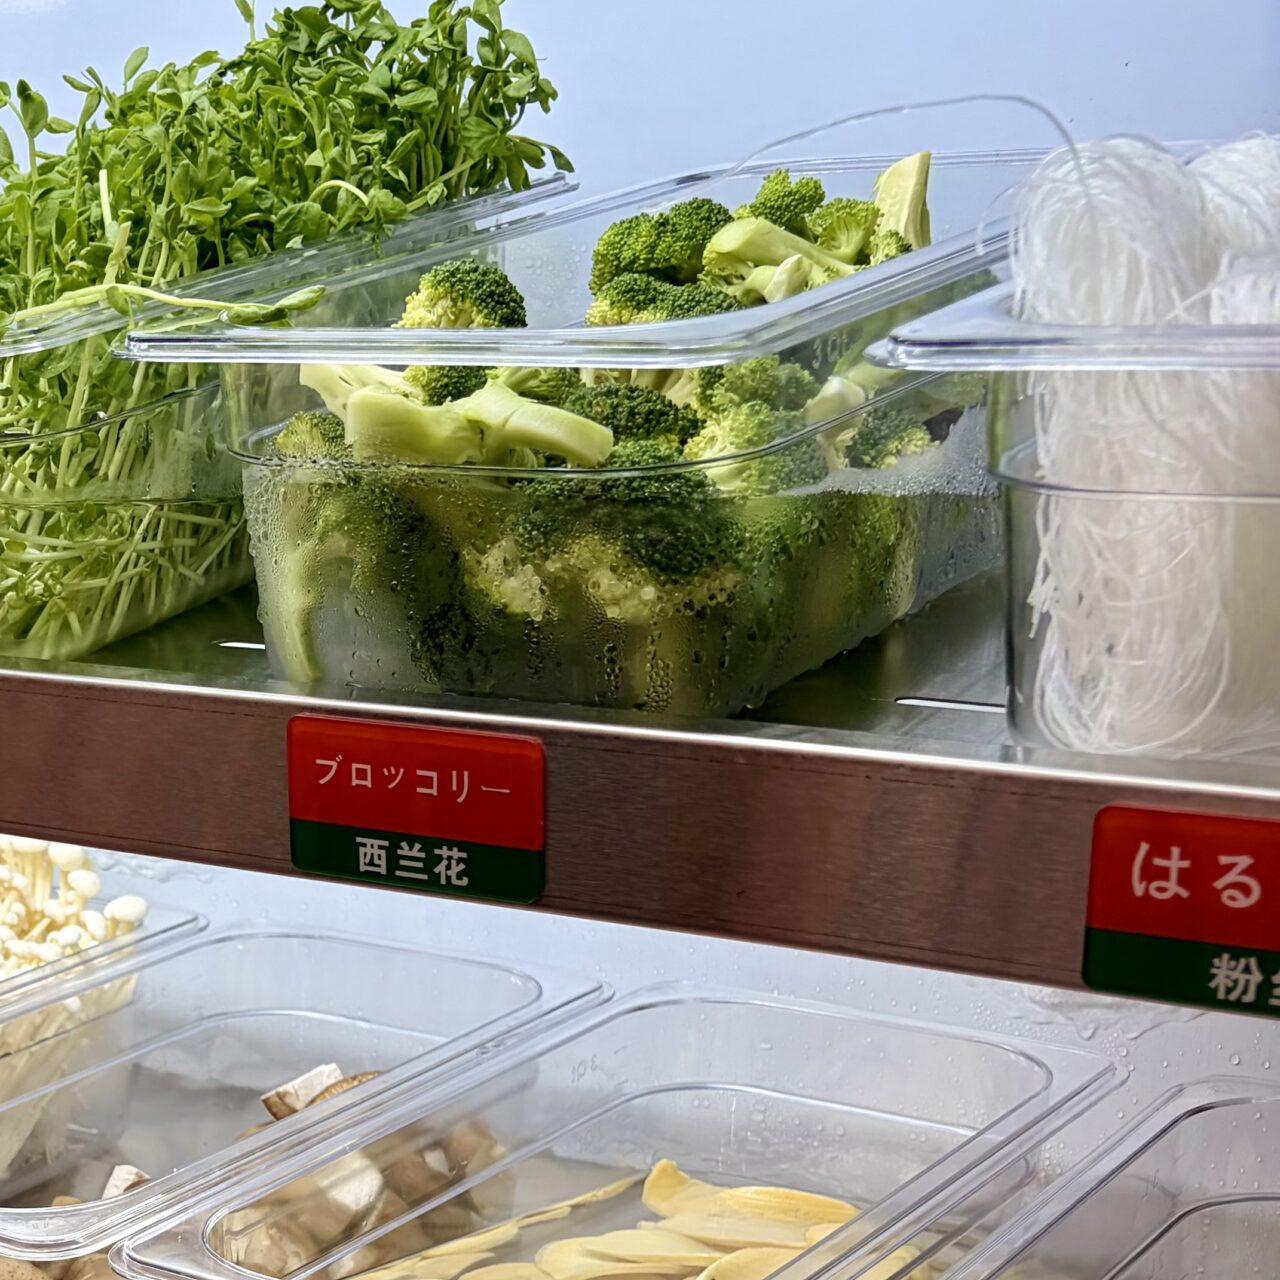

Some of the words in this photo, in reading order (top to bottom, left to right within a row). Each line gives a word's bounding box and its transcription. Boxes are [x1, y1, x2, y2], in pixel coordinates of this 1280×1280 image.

[315, 754, 511, 803] ブロッコリー
[355, 836, 470, 887] 西兰花
[1208, 953, 1280, 1006] 粉
